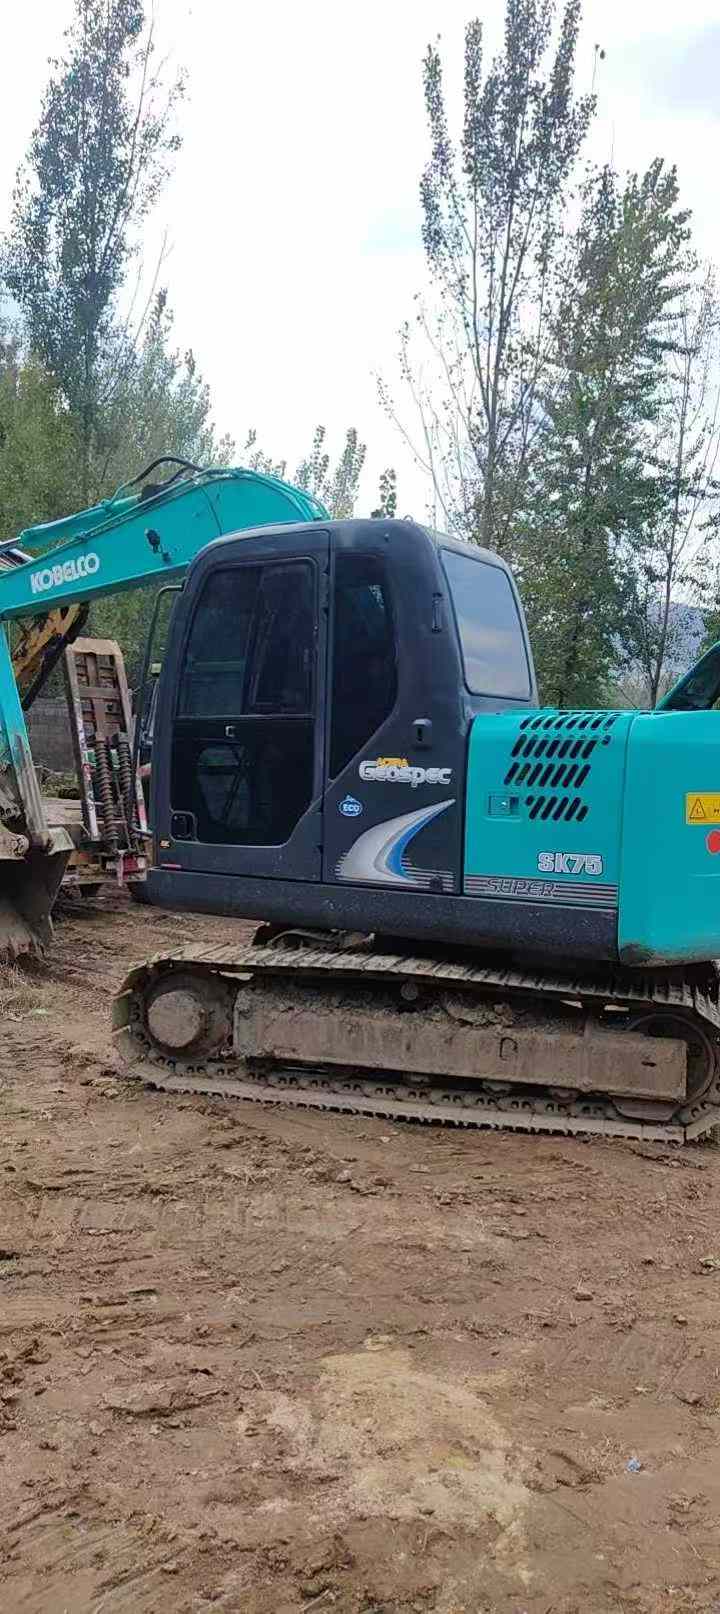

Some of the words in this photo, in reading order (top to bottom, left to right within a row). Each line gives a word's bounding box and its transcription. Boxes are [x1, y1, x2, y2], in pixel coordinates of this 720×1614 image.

[31, 553, 99, 593] KOBELCO
[359, 760, 452, 788] Geospec
[342, 803, 360, 812] ECO
[538, 852, 602, 875] SK75
[487, 878, 556, 897] SUPER
